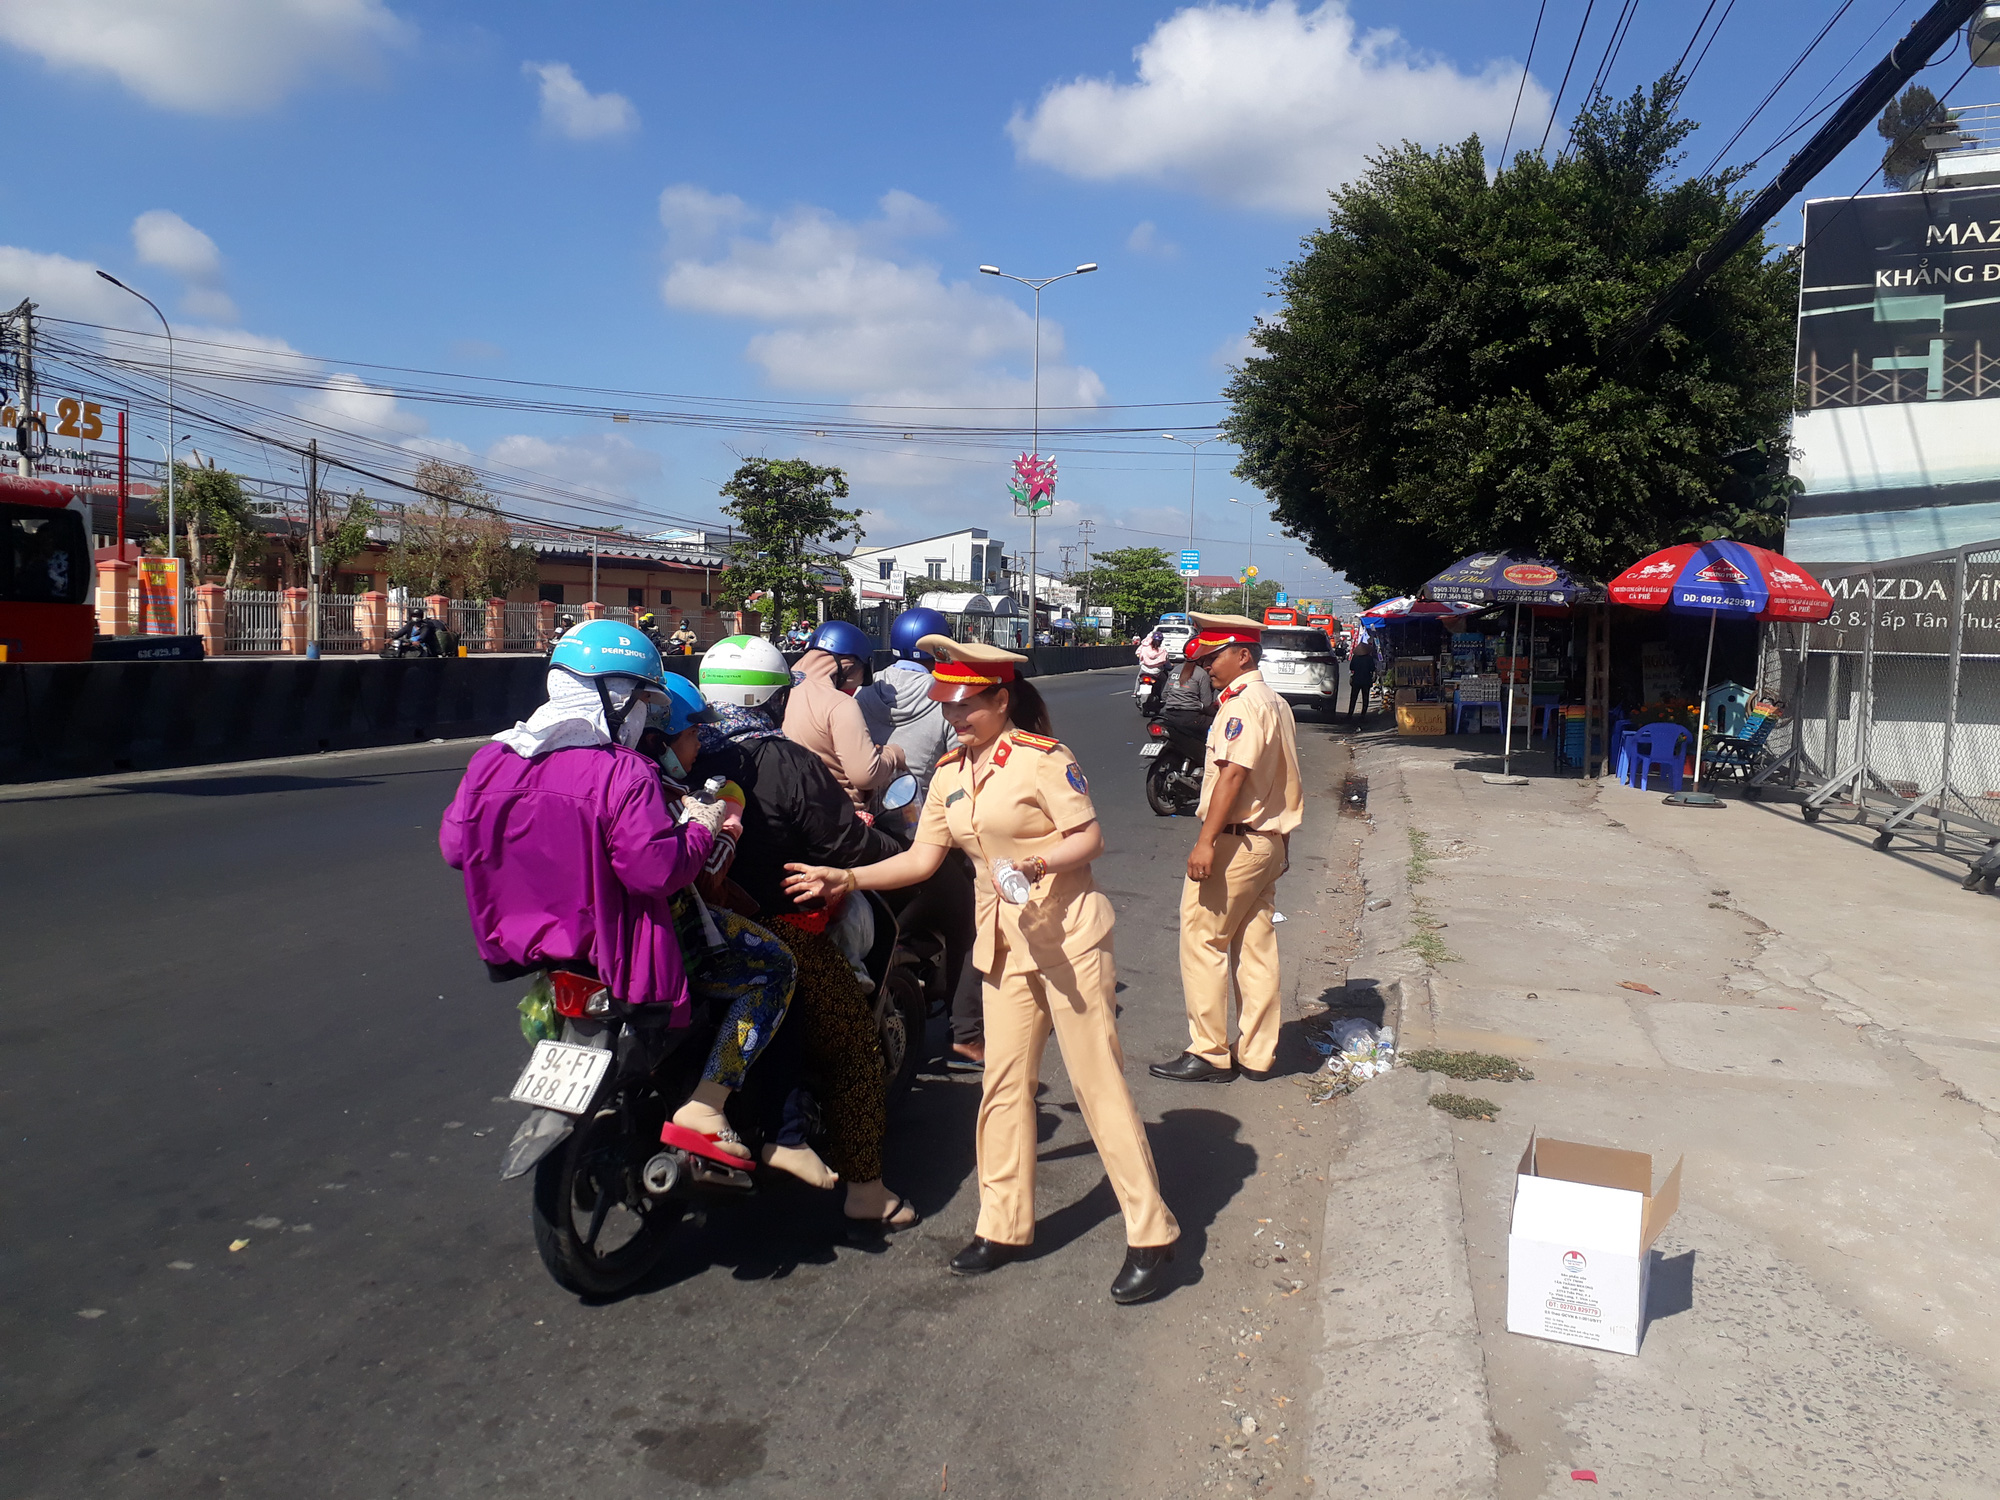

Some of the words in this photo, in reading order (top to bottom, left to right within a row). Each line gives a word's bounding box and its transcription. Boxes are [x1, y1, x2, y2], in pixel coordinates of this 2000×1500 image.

[55, 398, 103, 440] 25
[1822, 578, 1948, 600] MAZDA
[1701, 595, 1755, 608] 0912.429991
[1913, 612, 1948, 628] Tân
[521, 1074, 590, 1108] 188.11
